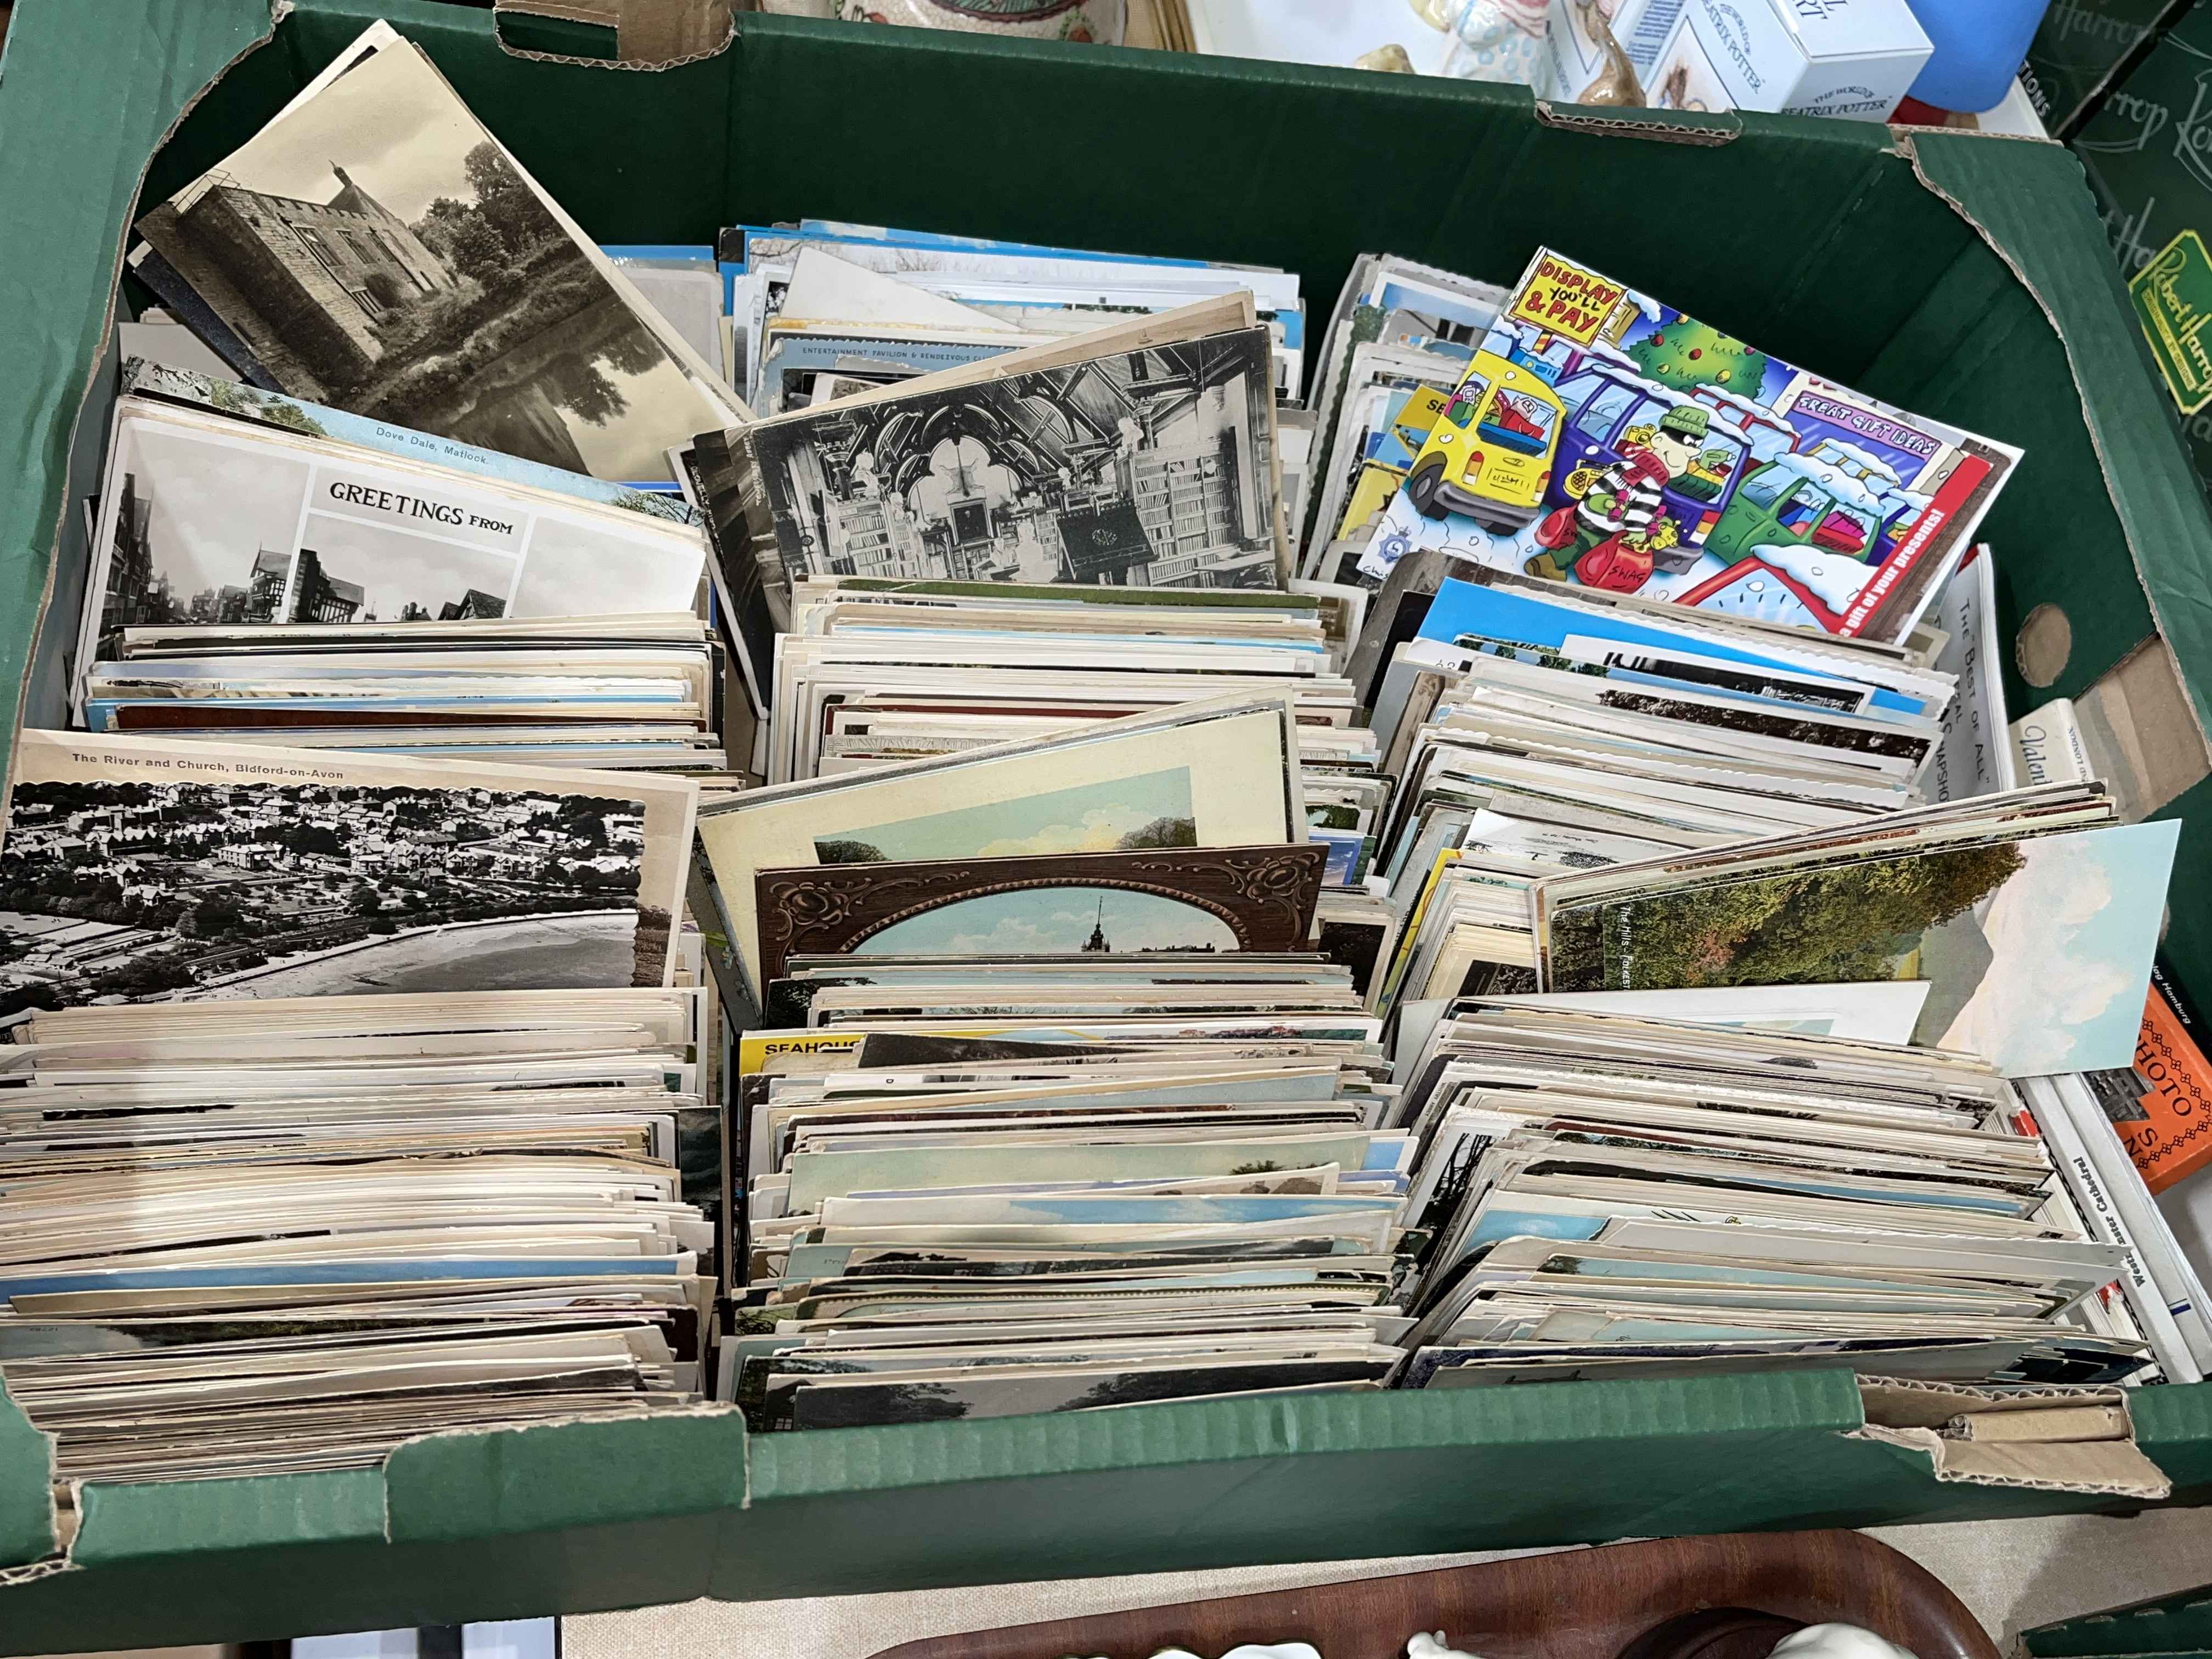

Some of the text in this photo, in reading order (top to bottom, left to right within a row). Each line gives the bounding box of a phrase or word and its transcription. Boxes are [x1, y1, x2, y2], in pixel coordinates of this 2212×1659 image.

[1727, 39, 1762, 94] POTTER
[1837, 99, 1887, 114] POTTER
[1540, 261, 1618, 306] DISPLAY
[1525, 291, 1599, 332] & PAY
[803, 347, 867, 356] ENTERTAINMENT
[376, 427, 489, 465] Dove Dale, Matlock.
[1798, 395, 1939, 455] GREAT GIFT IDEAS
[330, 482, 513, 535] GREETINGS FROM
[1609, 566, 1646, 583] SWAG
[1844, 602, 1866, 630] gift
[1864, 588, 1880, 608] of
[1875, 566, 1900, 596] your
[1897, 509, 1945, 569] presents!
[1960, 597, 1971, 640] THE
[1972, 710, 1979, 731] OF
[72, 753, 344, 780] The River and Church, Bidford-on-Avon
[2068, 726, 2084, 765] LONDON
[1620, 906, 1631, 923] The
[2162, 982, 2192, 1025] Hamburg
[2137, 1035, 2192, 1118] HOTO
[2073, 1156, 2108, 1213] Cathedral
